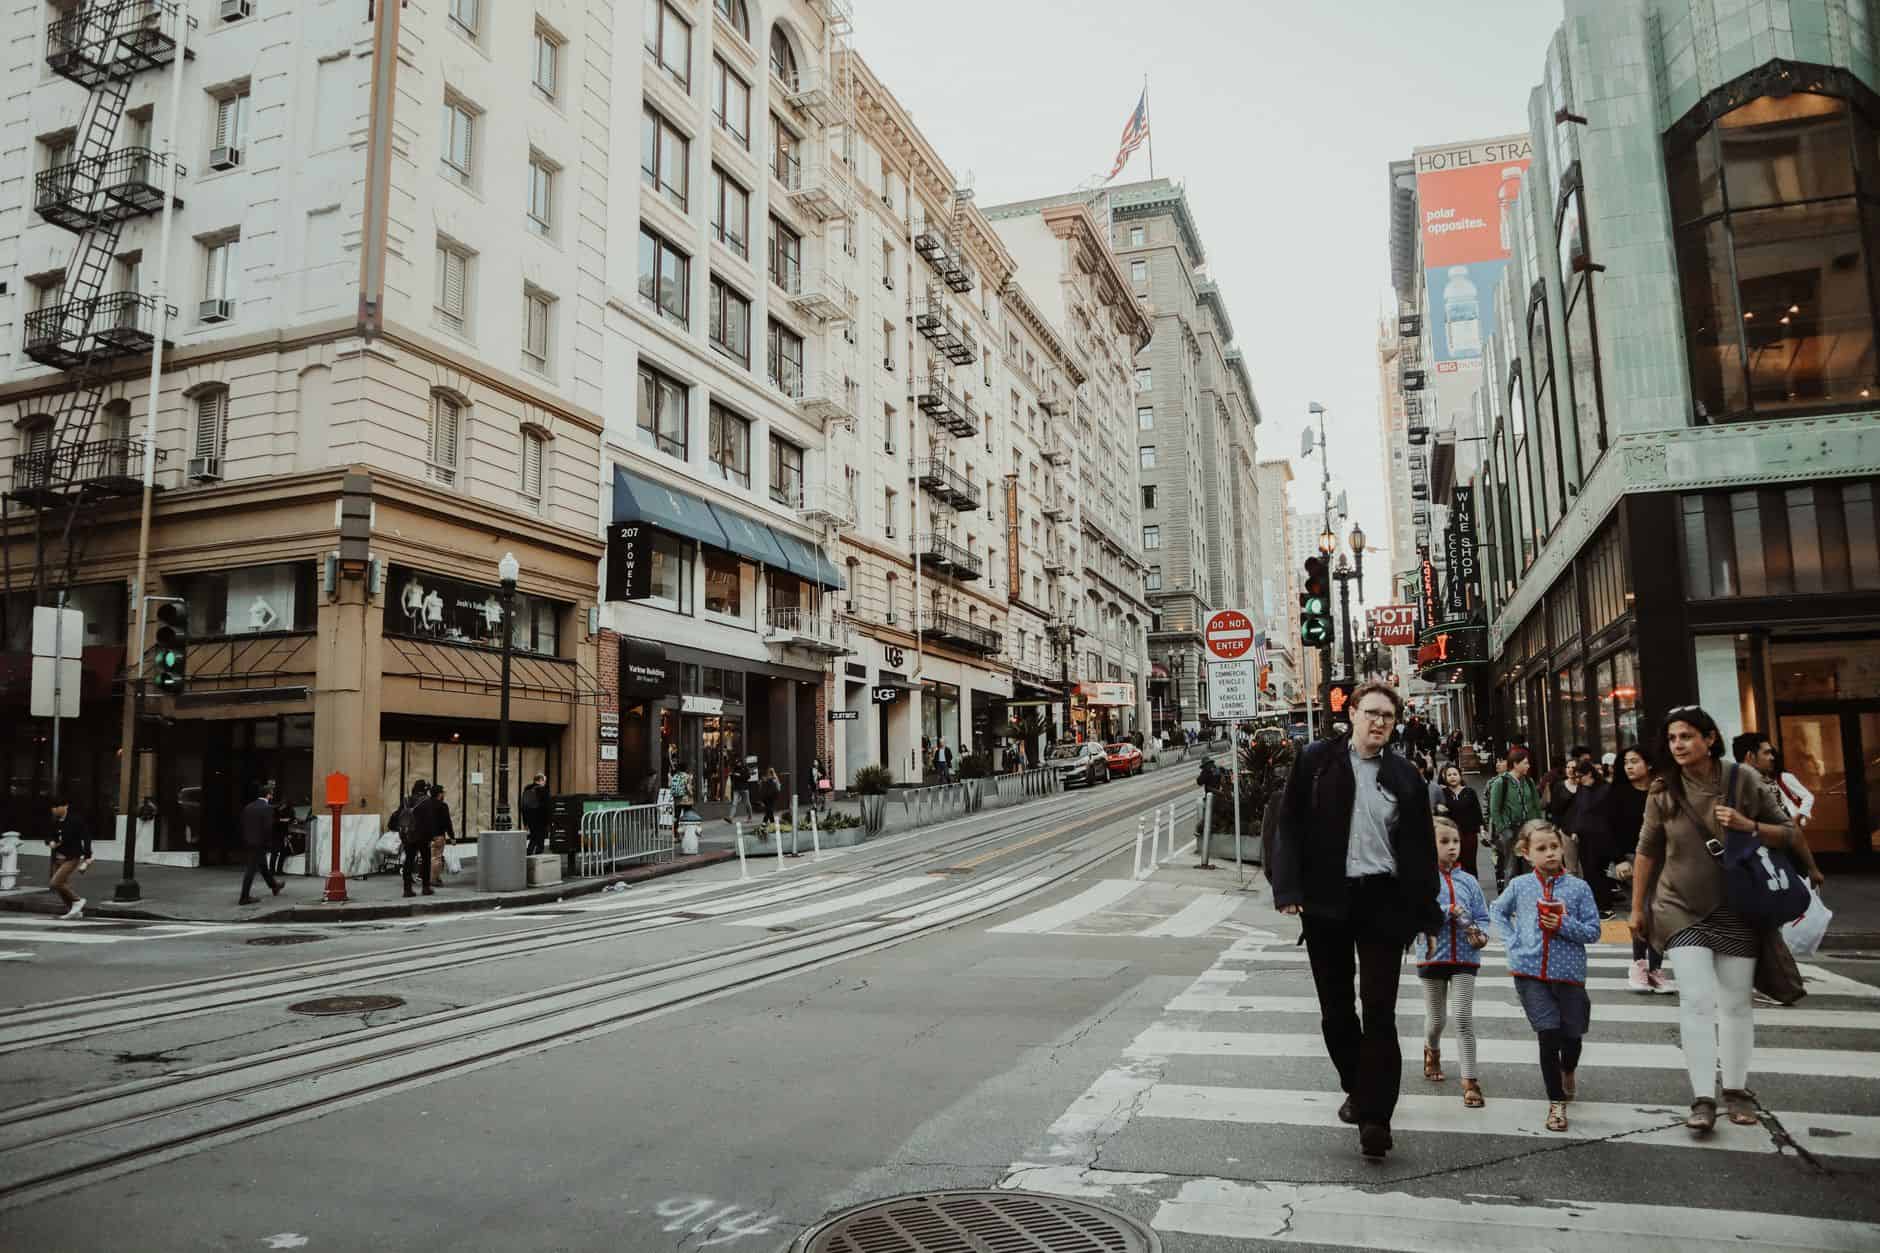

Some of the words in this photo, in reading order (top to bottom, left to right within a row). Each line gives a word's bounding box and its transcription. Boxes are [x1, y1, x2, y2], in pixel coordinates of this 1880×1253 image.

[1419, 149, 1480, 171] HOTEL
[1484, 141, 1533, 162] STRA
[1427, 208, 1455, 223] polar
[1428, 218, 1487, 236] opposites.
[1456, 492, 1470, 532] WINE
[621, 527, 639, 538] 207
[1461, 538, 1473, 577] SHOP
[626, 542, 635, 596] POWELL
[1448, 533, 1462, 607] COCKTAILS
[1212, 621, 1223, 629] DO
[1229, 619, 1246, 628] NOT
[1216, 641, 1244, 650] ENTER
[885, 645, 904, 668] UGG
[873, 689, 896, 701] UGG
